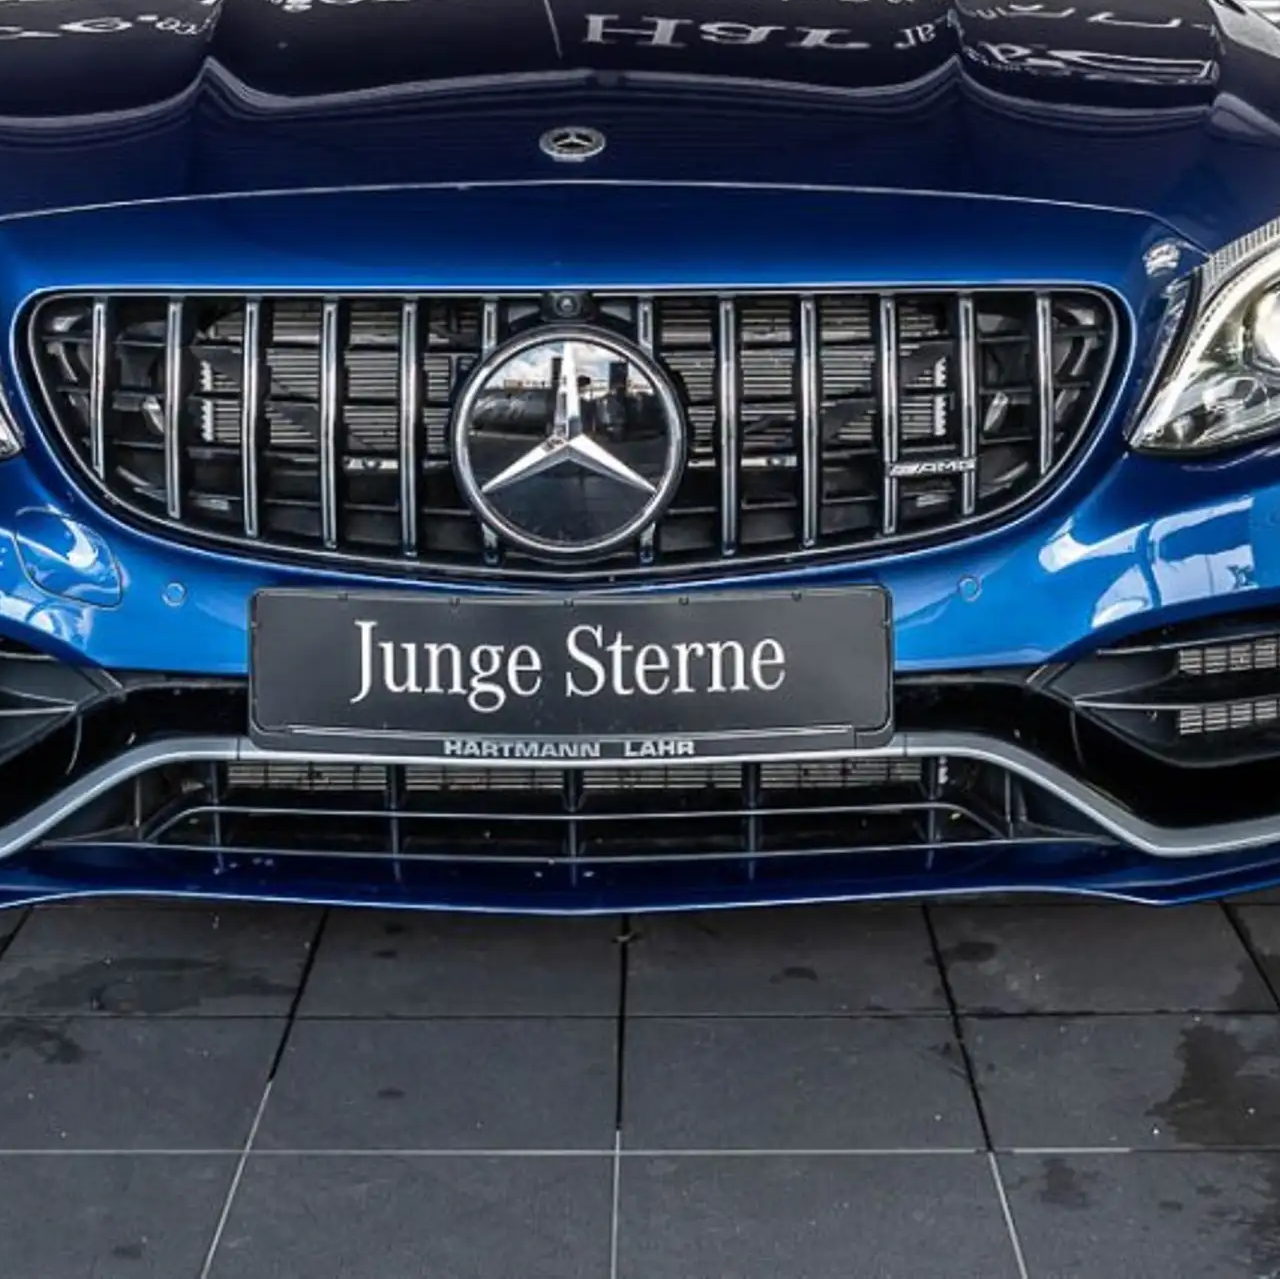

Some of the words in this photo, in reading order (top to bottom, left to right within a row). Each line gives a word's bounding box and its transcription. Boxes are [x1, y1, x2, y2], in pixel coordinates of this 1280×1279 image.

[350, 619, 542, 714] Junge
[565, 624, 786, 698] Sterne
[444, 739, 601, 758] HARTMANN
[623, 739, 696, 757] LAHR
